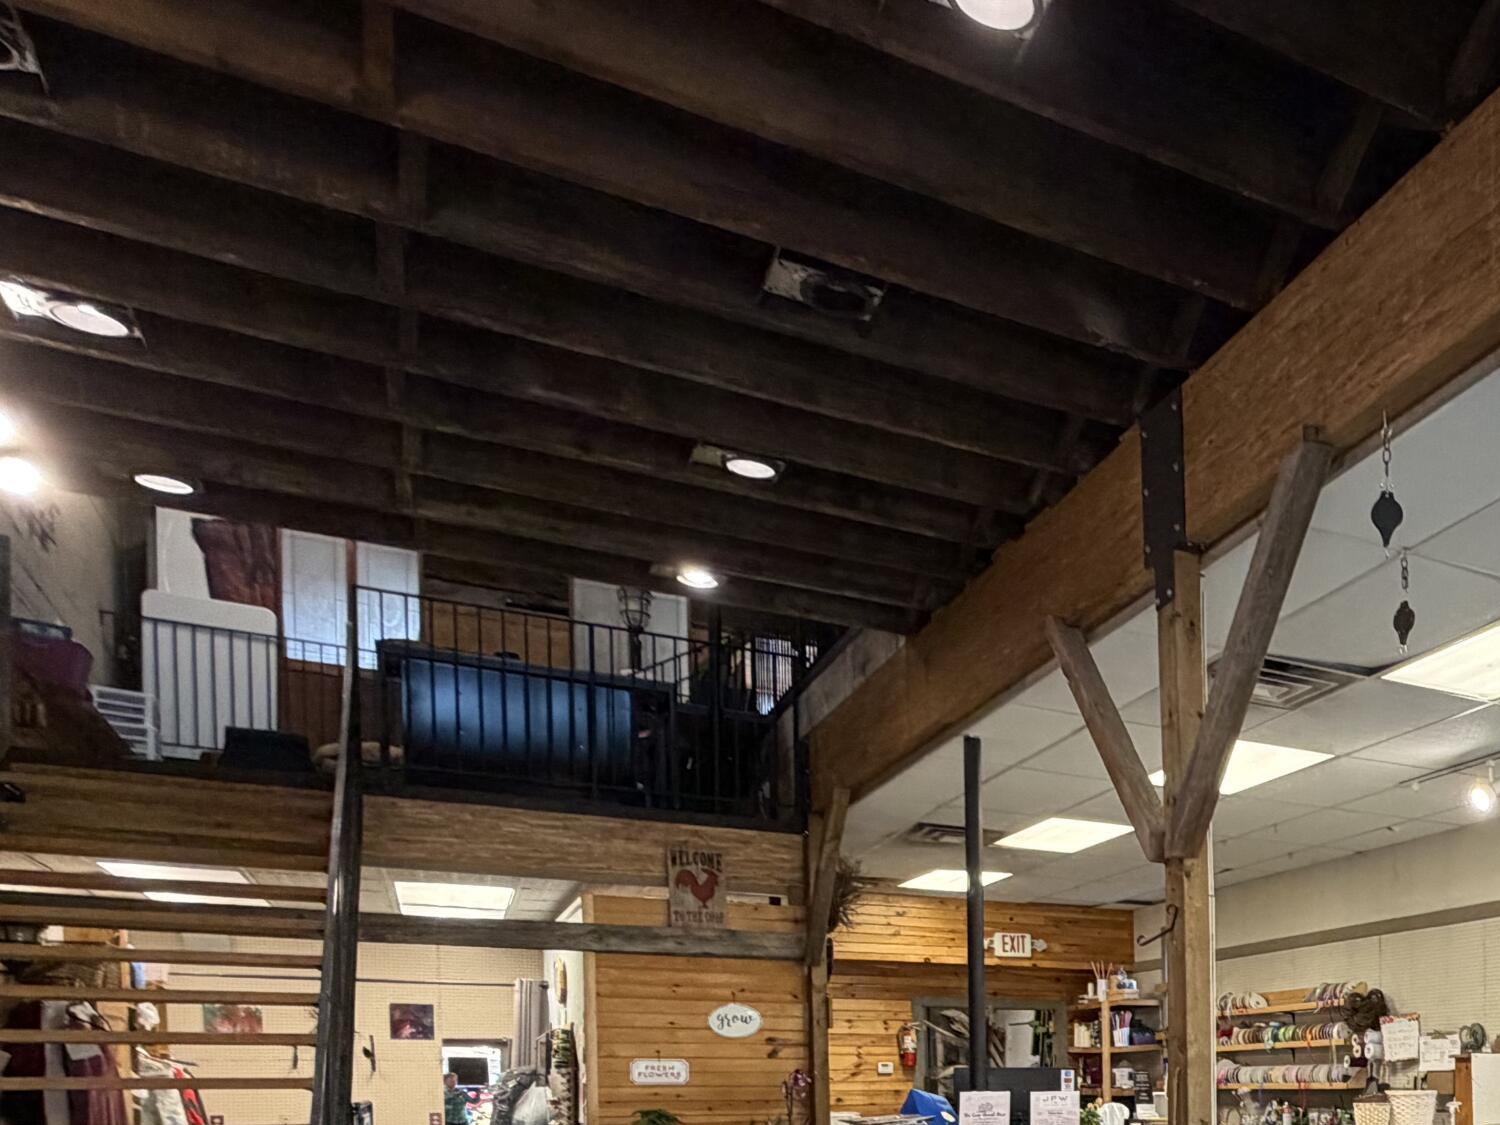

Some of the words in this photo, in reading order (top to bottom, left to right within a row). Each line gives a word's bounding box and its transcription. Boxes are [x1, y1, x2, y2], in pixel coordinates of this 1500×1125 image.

[671, 850, 722, 872] WELCOME
[1002, 934, 1027, 953] EXIT
[716, 1013, 753, 1030] grow
